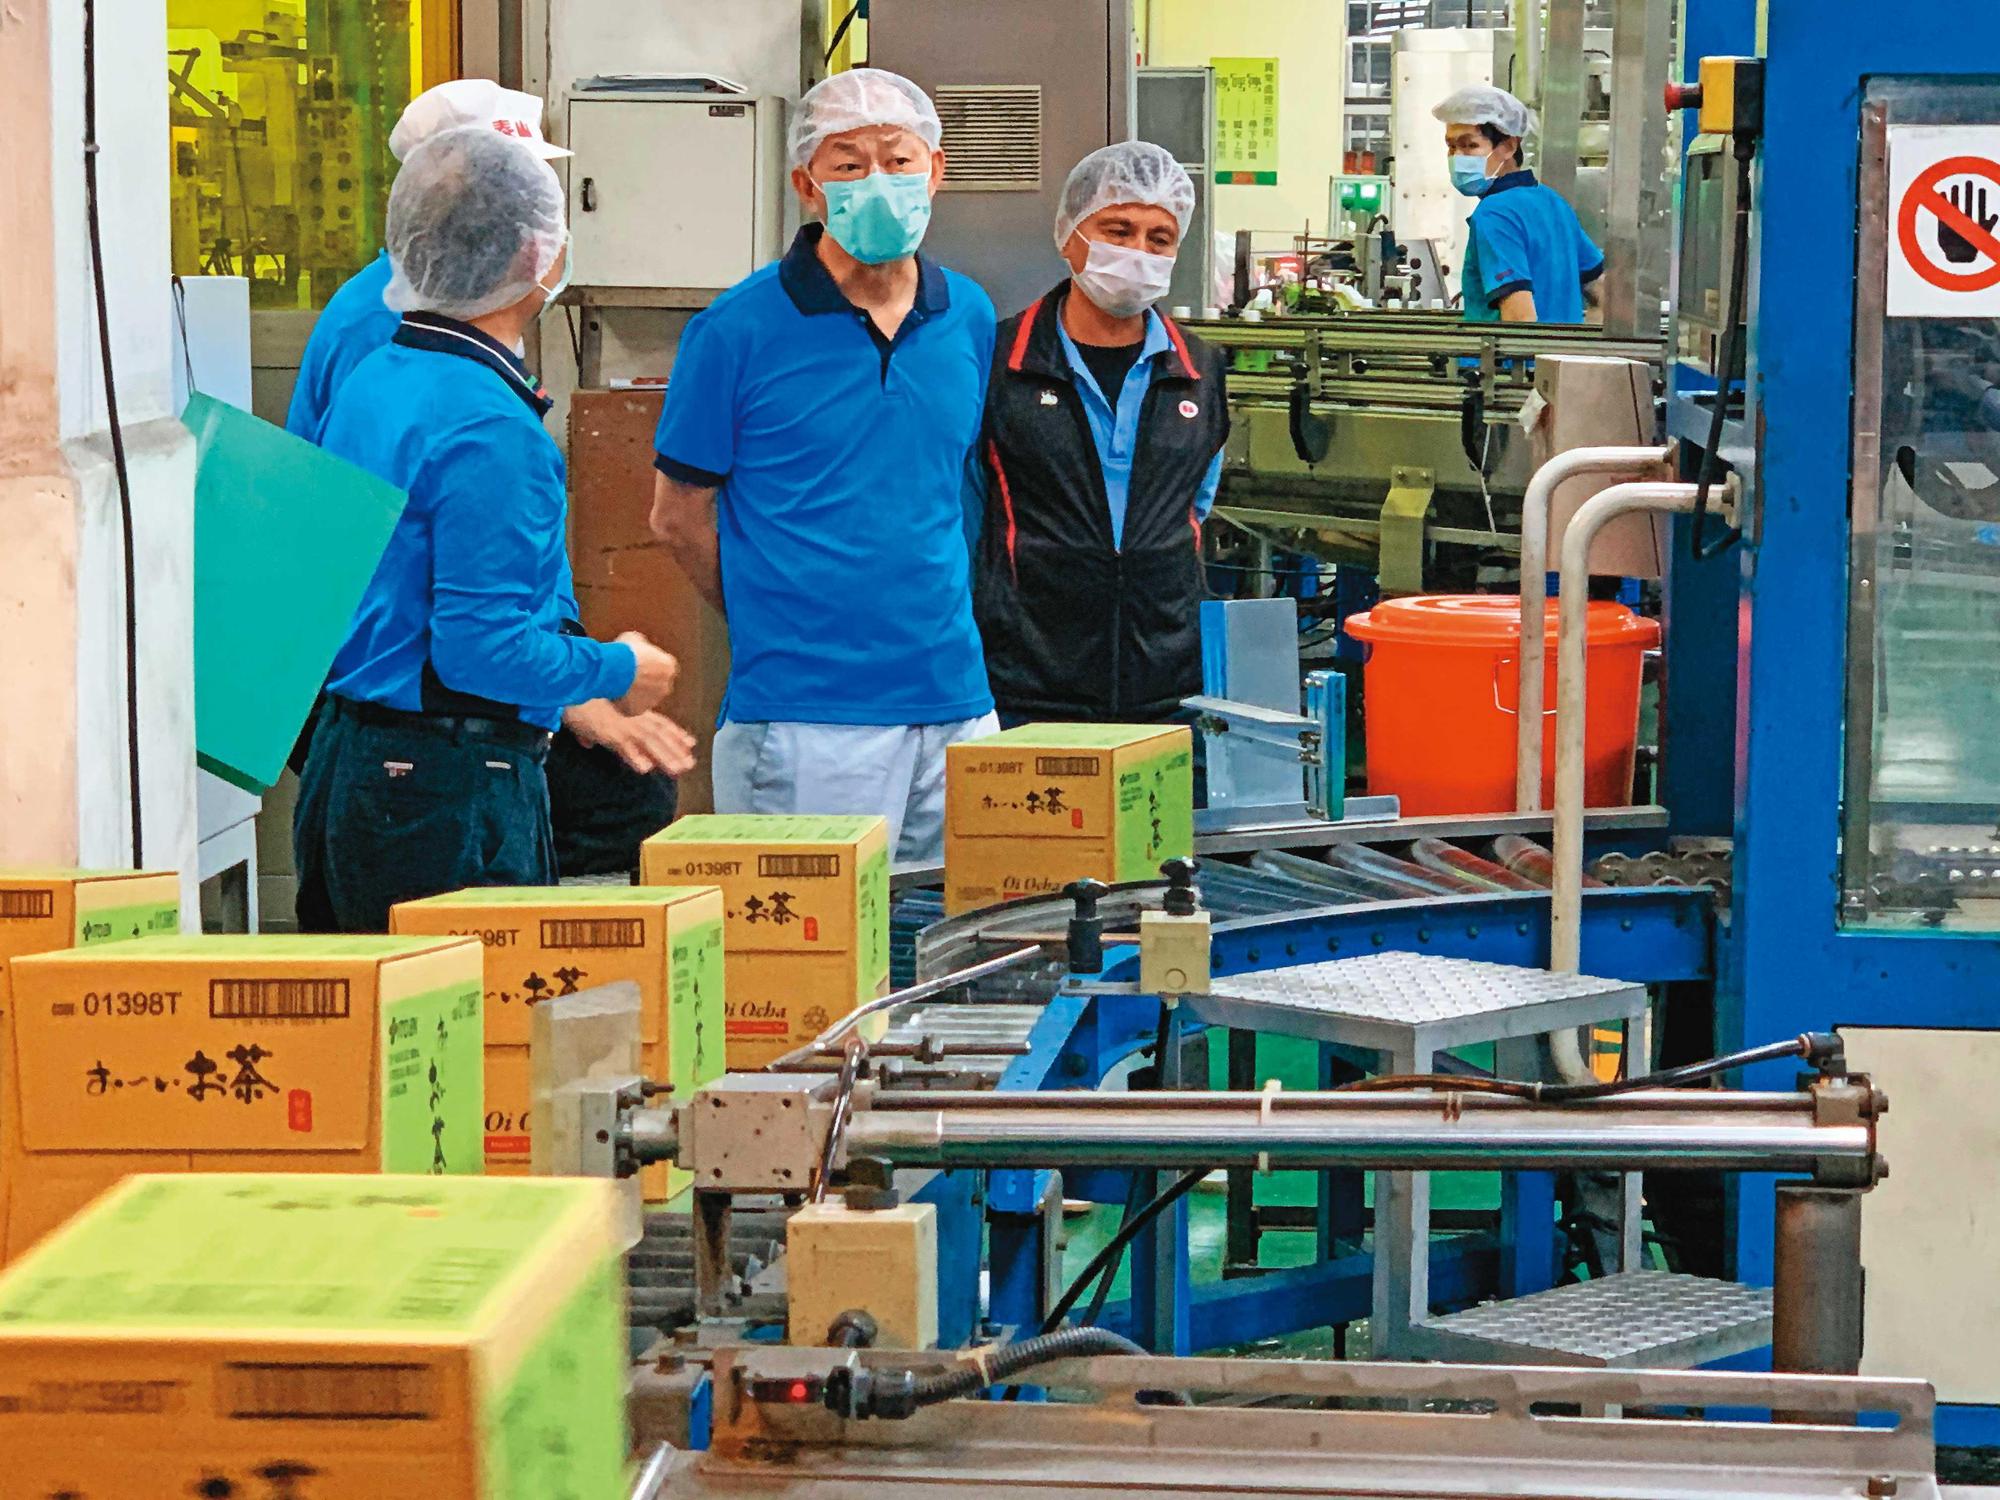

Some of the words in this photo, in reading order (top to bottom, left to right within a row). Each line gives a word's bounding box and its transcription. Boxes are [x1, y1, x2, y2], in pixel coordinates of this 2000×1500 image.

[685, 861, 742, 876] 01398T
[83, 991, 182, 1016] 01398T
[485, 1110, 512, 1132] Oi
